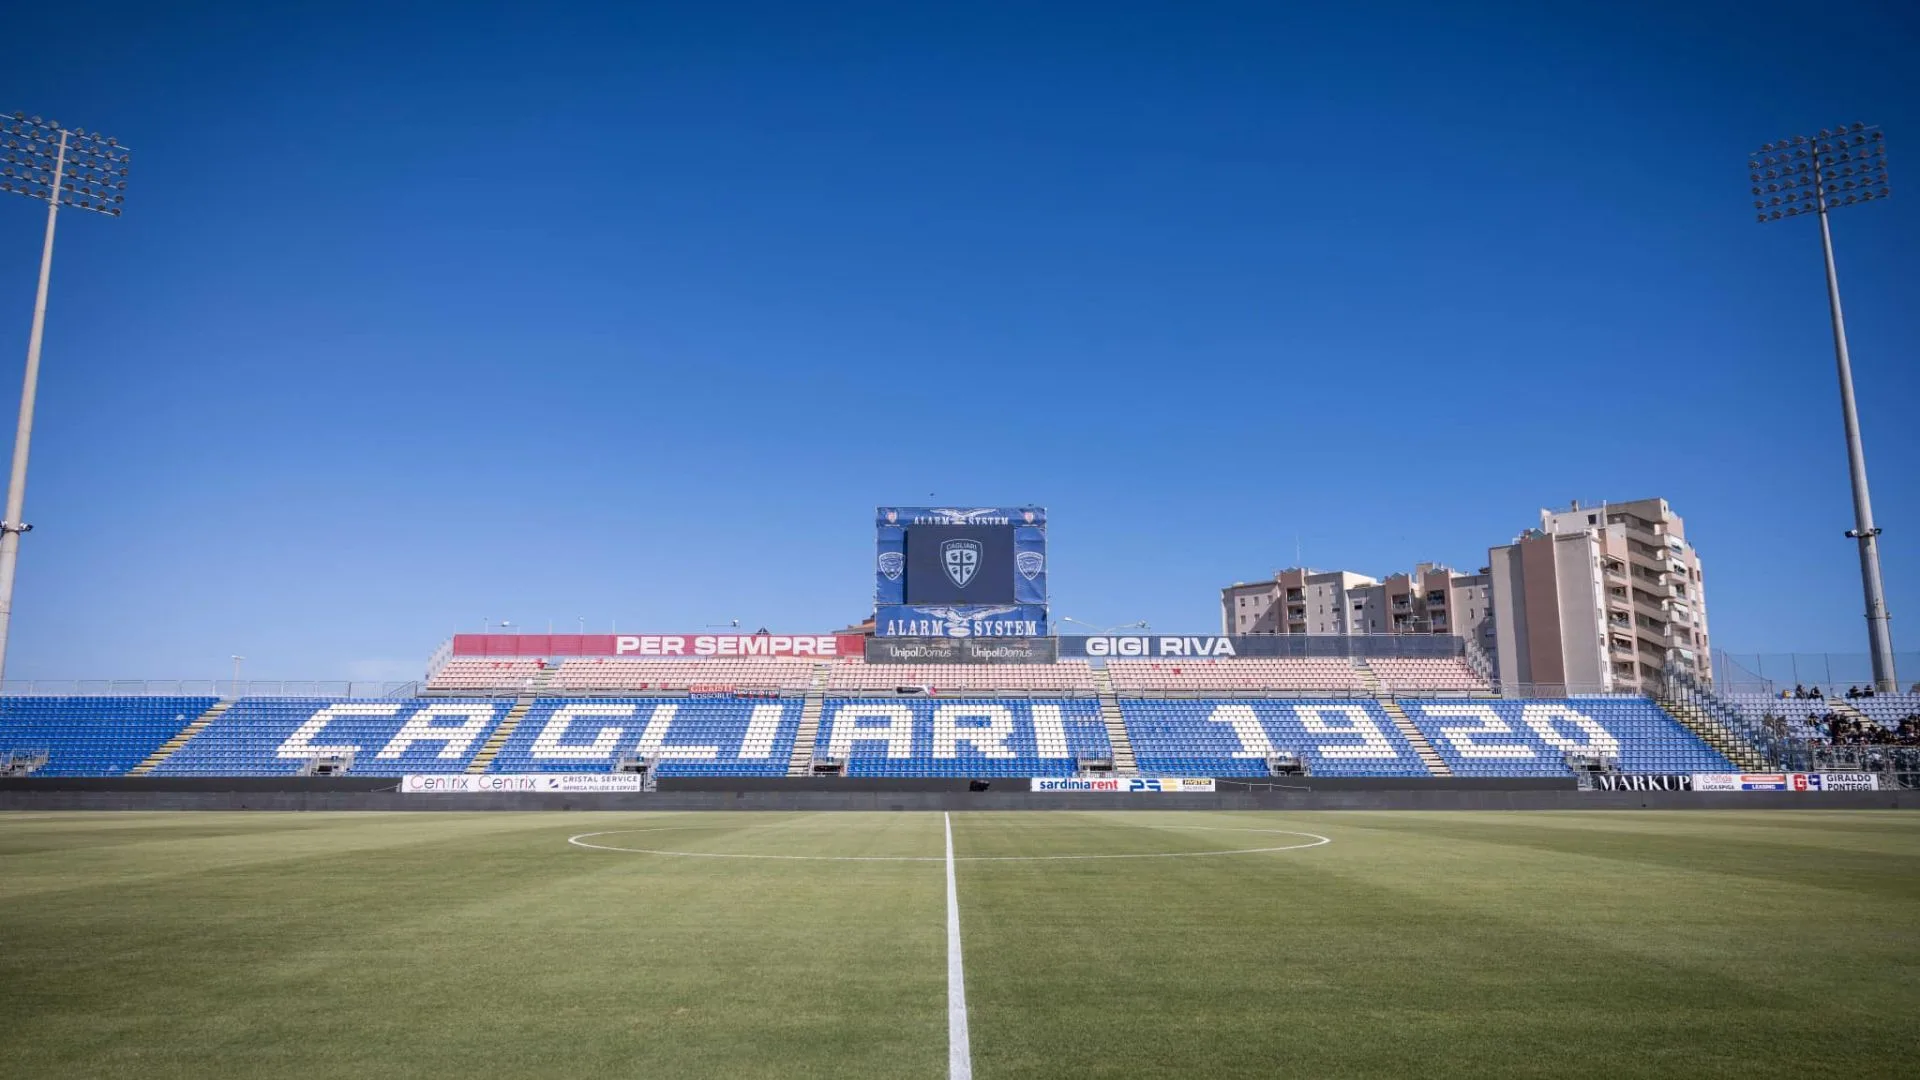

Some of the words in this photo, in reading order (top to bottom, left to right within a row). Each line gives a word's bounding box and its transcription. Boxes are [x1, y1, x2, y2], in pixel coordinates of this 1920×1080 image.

[914, 516, 950, 525] ALARM
[968, 516, 1009, 525] SYSTEM
[886, 619, 944, 636] ALARM
[973, 620, 1037, 636] SYSTEM
[615, 636, 684, 655] PER
[694, 636, 837, 655] SEMPRE
[890, 646, 951, 659] UnipolDomus
[971, 646, 1032, 659] UnipolDomus
[1085, 636, 1149, 656] GIGI
[1159, 636, 1236, 656] RIVA
[1207, 703, 1619, 759] 1920
[410, 774, 468, 789] Centrix
[478, 774, 536, 789] Centrix
[562, 775, 598, 783] CRISTAL
[601, 775, 637, 783] SERVICE
[1039, 778, 1118, 790] sardiniarent
[1599, 775, 1690, 791] MARKUP
[1826, 774, 1871, 782] GIRALDO
[1827, 783, 1872, 791] PONTEGGI
